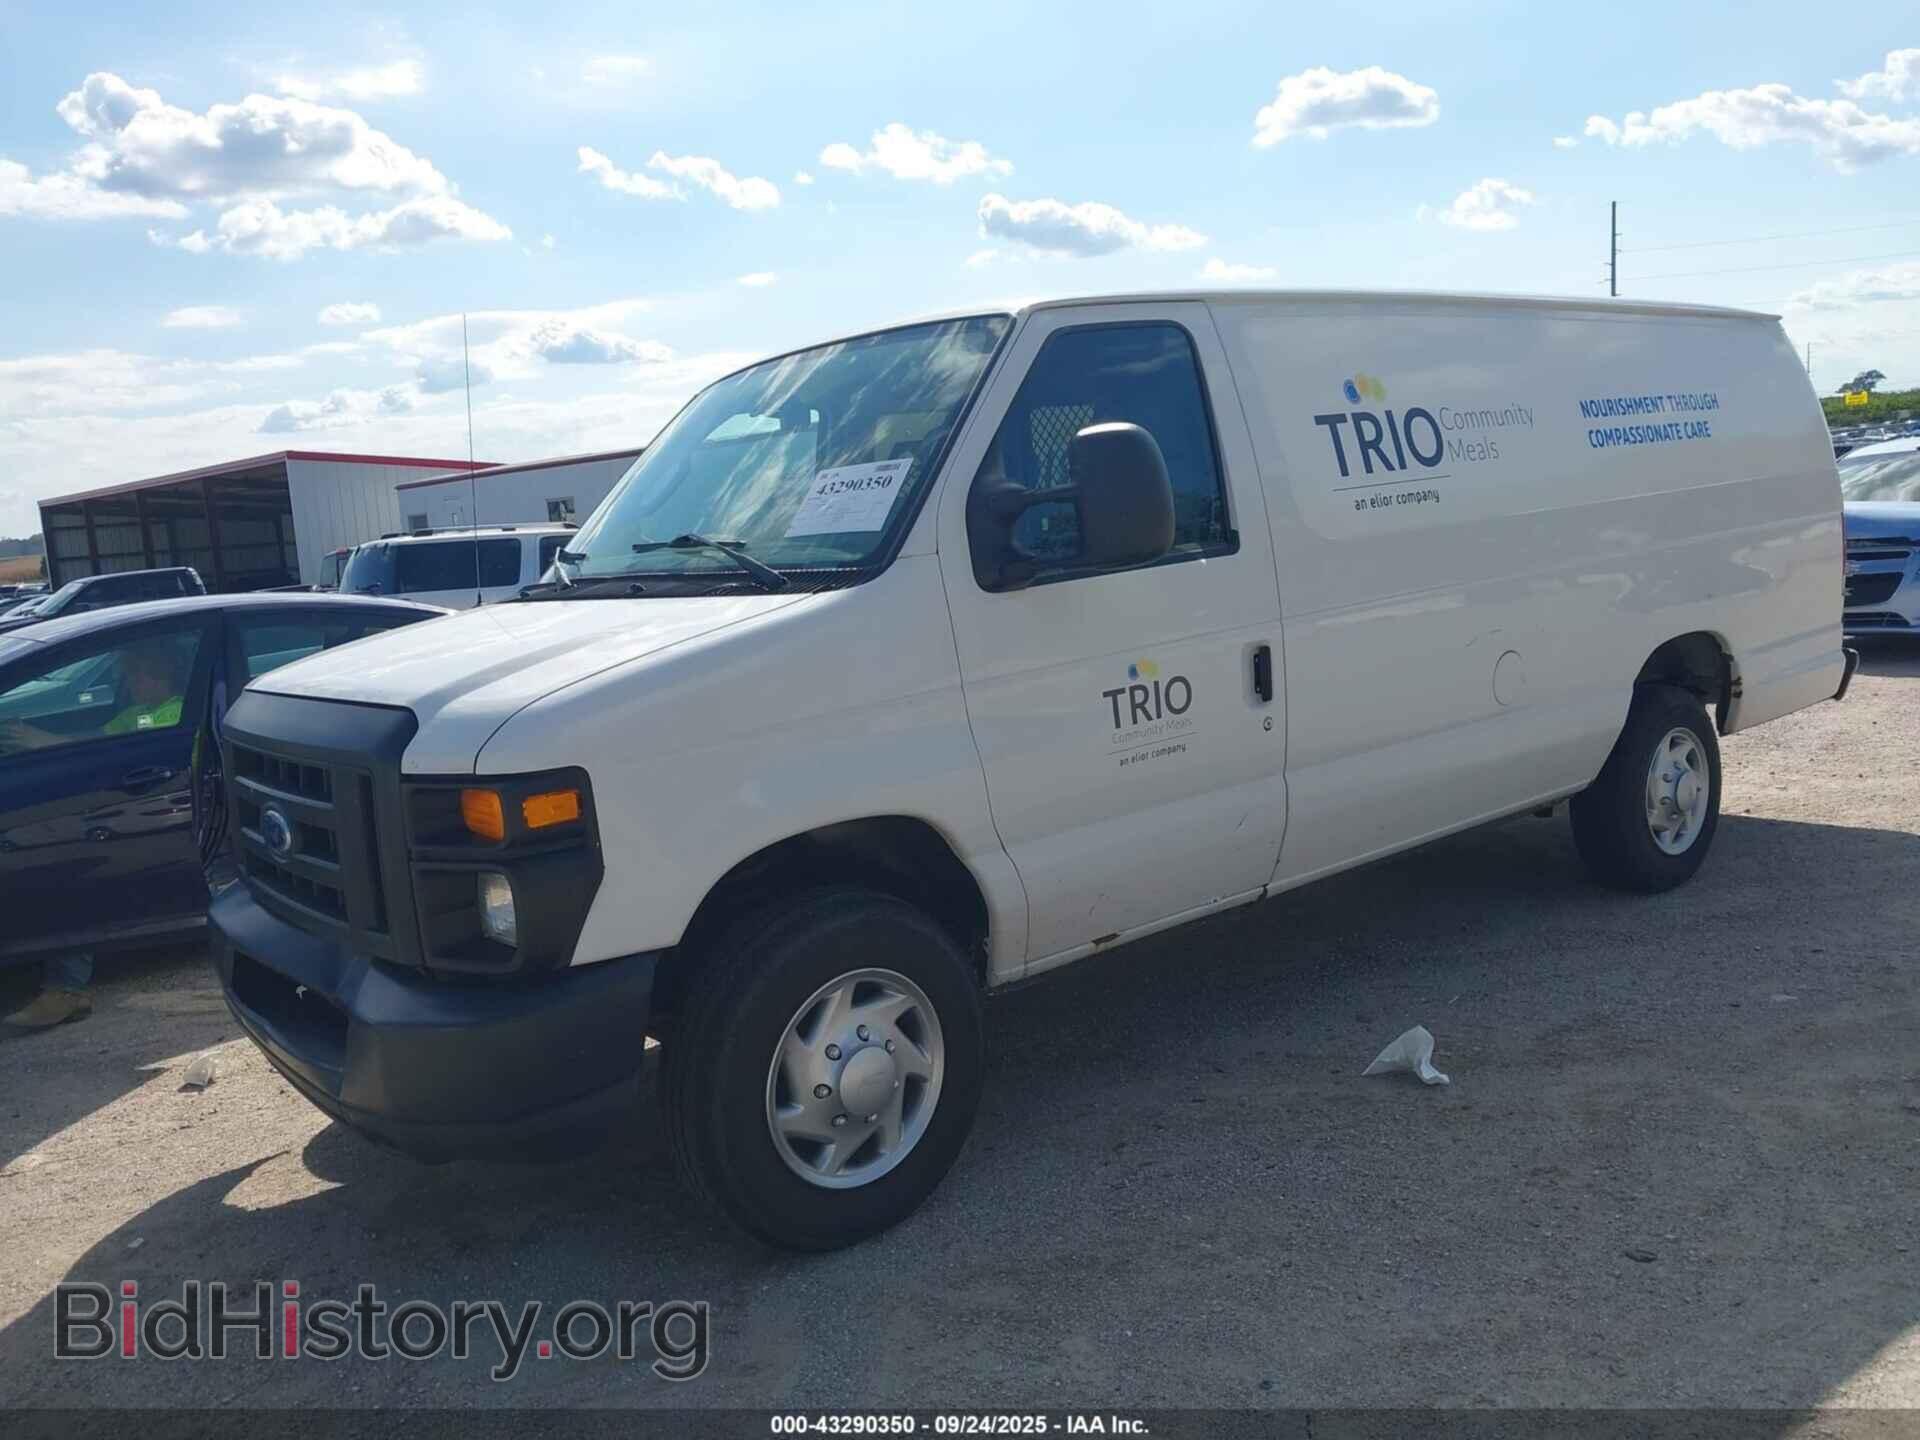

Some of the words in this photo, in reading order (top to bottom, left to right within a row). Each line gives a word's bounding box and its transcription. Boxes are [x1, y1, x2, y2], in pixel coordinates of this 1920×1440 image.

[1439, 402, 1535, 431] Community
[1579, 396, 1664, 418] NOURISHMENT
[1667, 392, 1720, 413] THROUGH
[1314, 407, 1444, 477] TRIO
[1588, 422, 1683, 448] COMPASSIONATE
[1684, 420, 1711, 439] CARE
[1447, 436, 1500, 463] Meals
[815, 474, 894, 497] 43290350
[1354, 497, 1368, 511] an
[1370, 492, 1393, 509] elior
[1396, 488, 1441, 506] company
[1102, 675, 1193, 729] TRIO
[1151, 743, 1187, 759] company
